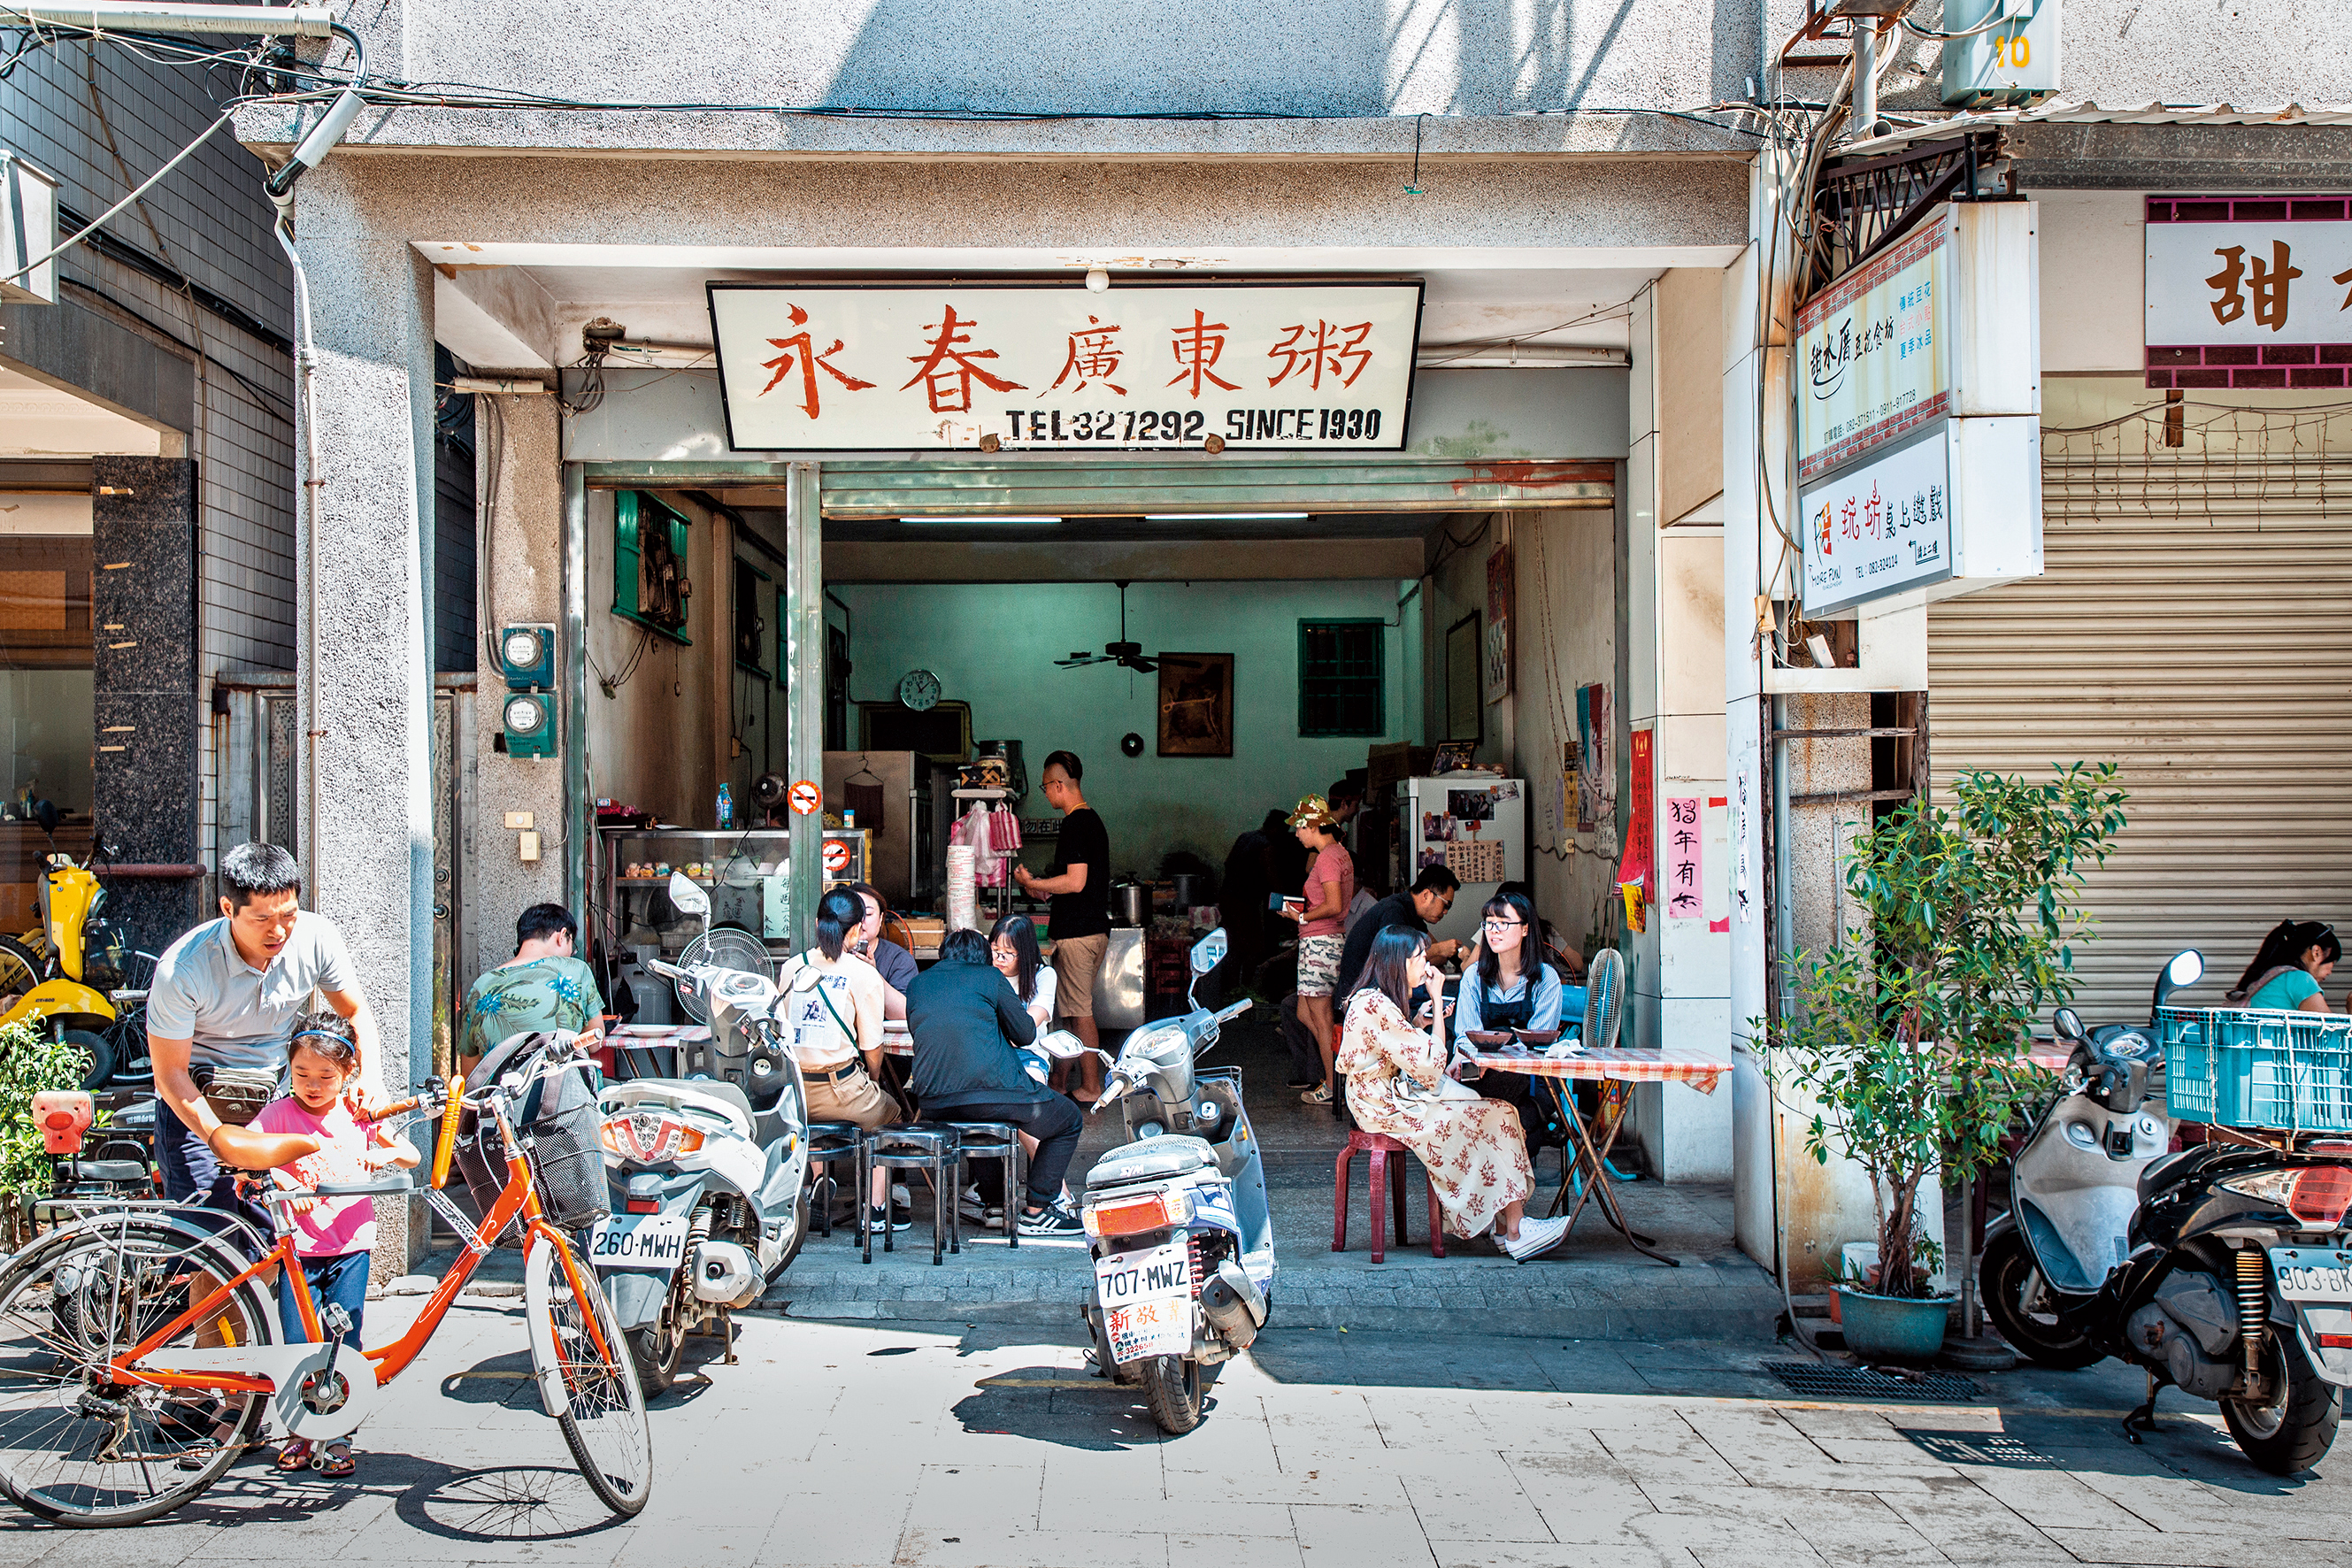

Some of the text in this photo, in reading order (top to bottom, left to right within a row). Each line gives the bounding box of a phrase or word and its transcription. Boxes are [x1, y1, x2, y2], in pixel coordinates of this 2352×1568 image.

[1995, 36, 2030, 67] 10
[1900, 281, 1931, 312] 傳統豆花
[2205, 240, 2352, 332] 甜
[1900, 304, 1931, 335] 台式小點
[1900, 329, 1931, 360] 夏季冰品
[759, 303, 1373, 419] 永春廣東粥
[1119, 1164, 1144, 1177] SYM
